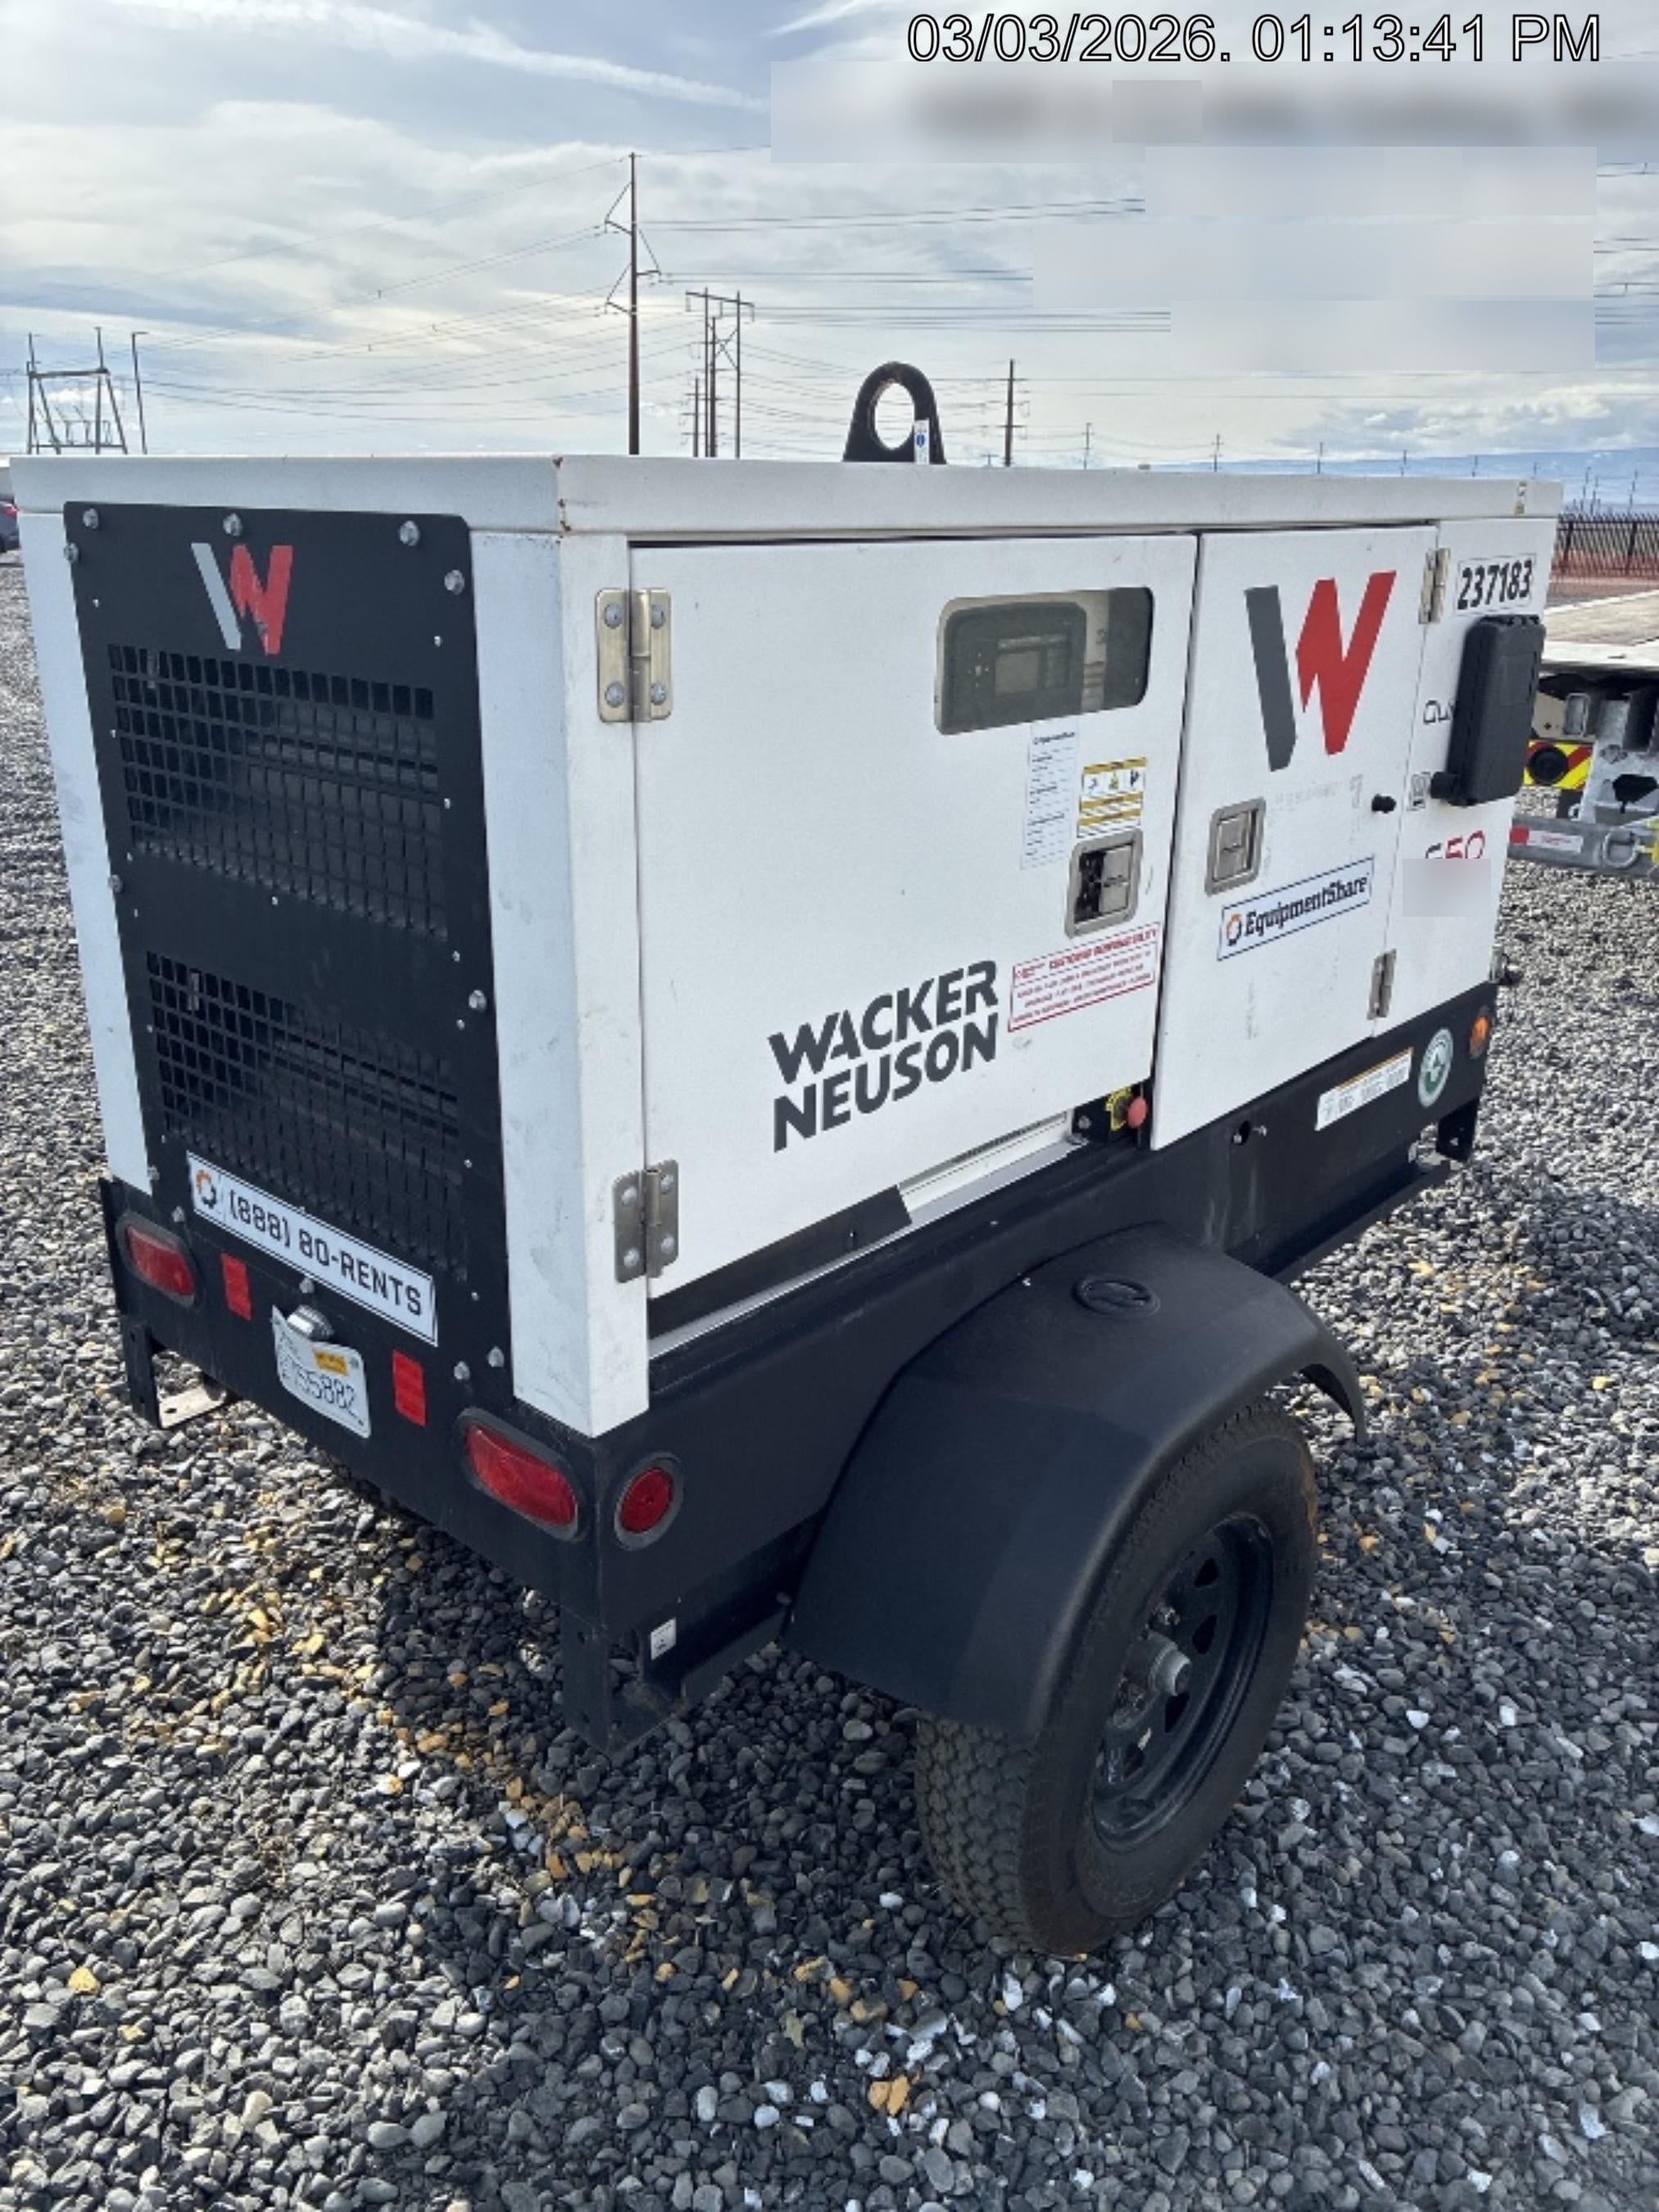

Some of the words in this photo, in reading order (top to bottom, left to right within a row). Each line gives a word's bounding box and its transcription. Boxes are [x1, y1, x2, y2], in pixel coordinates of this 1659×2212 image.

[1457, 559, 1533, 610] 237183
[1244, 876, 1367, 937] EquipmentShare
[768, 959, 999, 1085] WACKER
[773, 1013, 999, 1154] NEUSON
[229, 1189, 291, 1249] (888)
[298, 1228, 422, 1317] 80-RENTS
